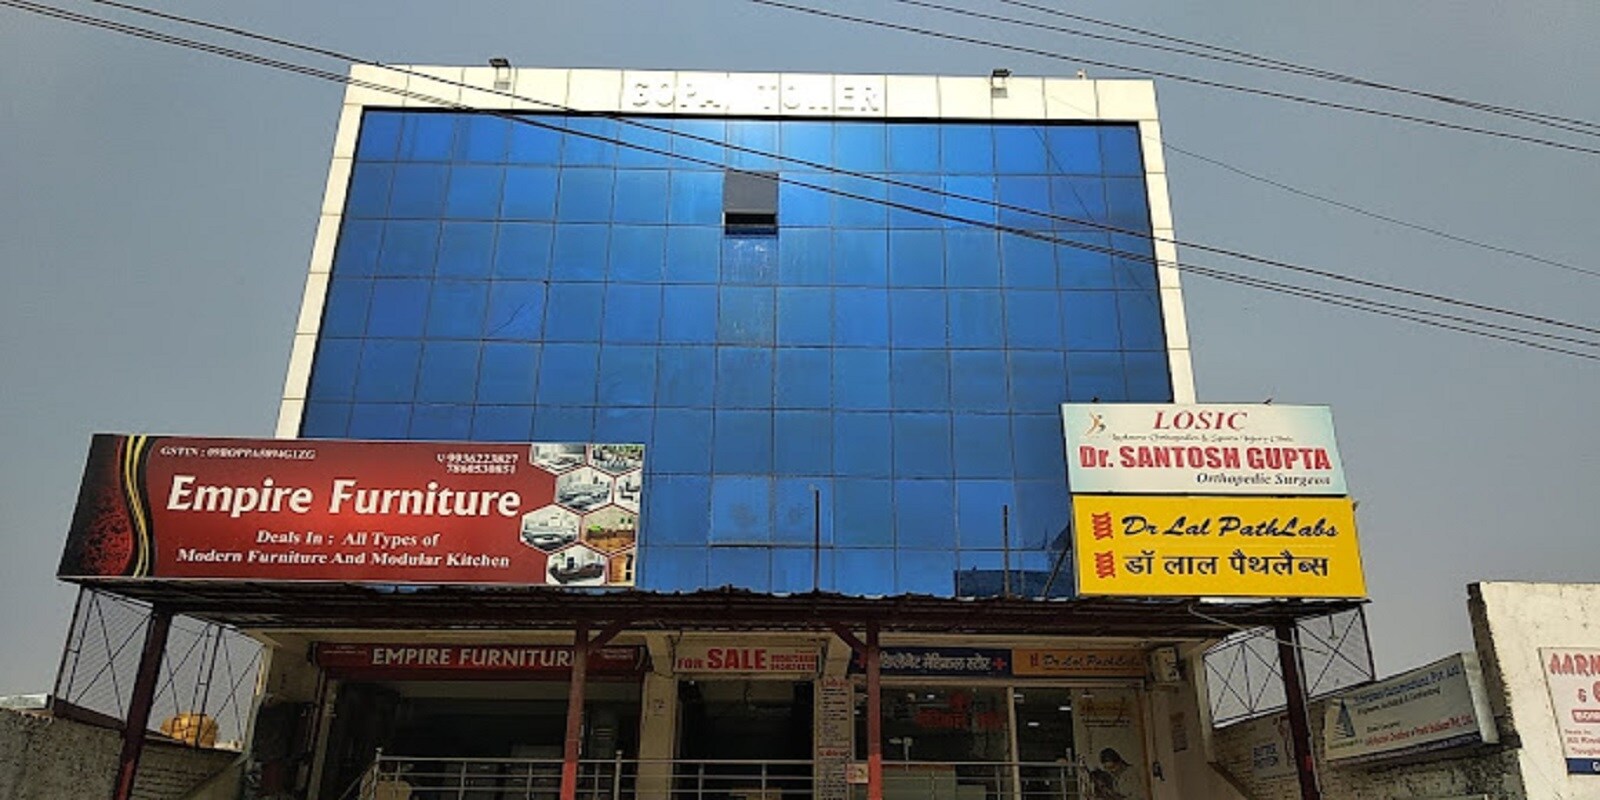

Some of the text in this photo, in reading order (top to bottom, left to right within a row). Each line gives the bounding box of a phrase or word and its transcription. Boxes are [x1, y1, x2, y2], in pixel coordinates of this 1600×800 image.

[632, 82, 729, 109] GOPA
[1153, 410, 1248, 430] LOSIC
[1079, 445, 1332, 471] Dr. SANTOSH GUPTA
[1196, 472, 1331, 489] Orthopedic Surgeon
[166, 475, 521, 518] Empire Furniture
[1121, 515, 1337, 538] Dr Lal PathLabs
[256, 529, 301, 545] Deals
[305, 530, 323, 545] In
[342, 531, 367, 547] All
[372, 532, 417, 550] Types
[421, 532, 440, 548] of
[176, 548, 510, 568] Modern Furniture And Modular Kitchen
[1122, 549, 1330, 576] डॉ लाल पैथलैब्स
[372, 648, 450, 665] EMPIRE
[459, 648, 576, 666] FURNITUR
[677, 658, 703, 669] FOR
[707, 648, 767, 670] SALE
